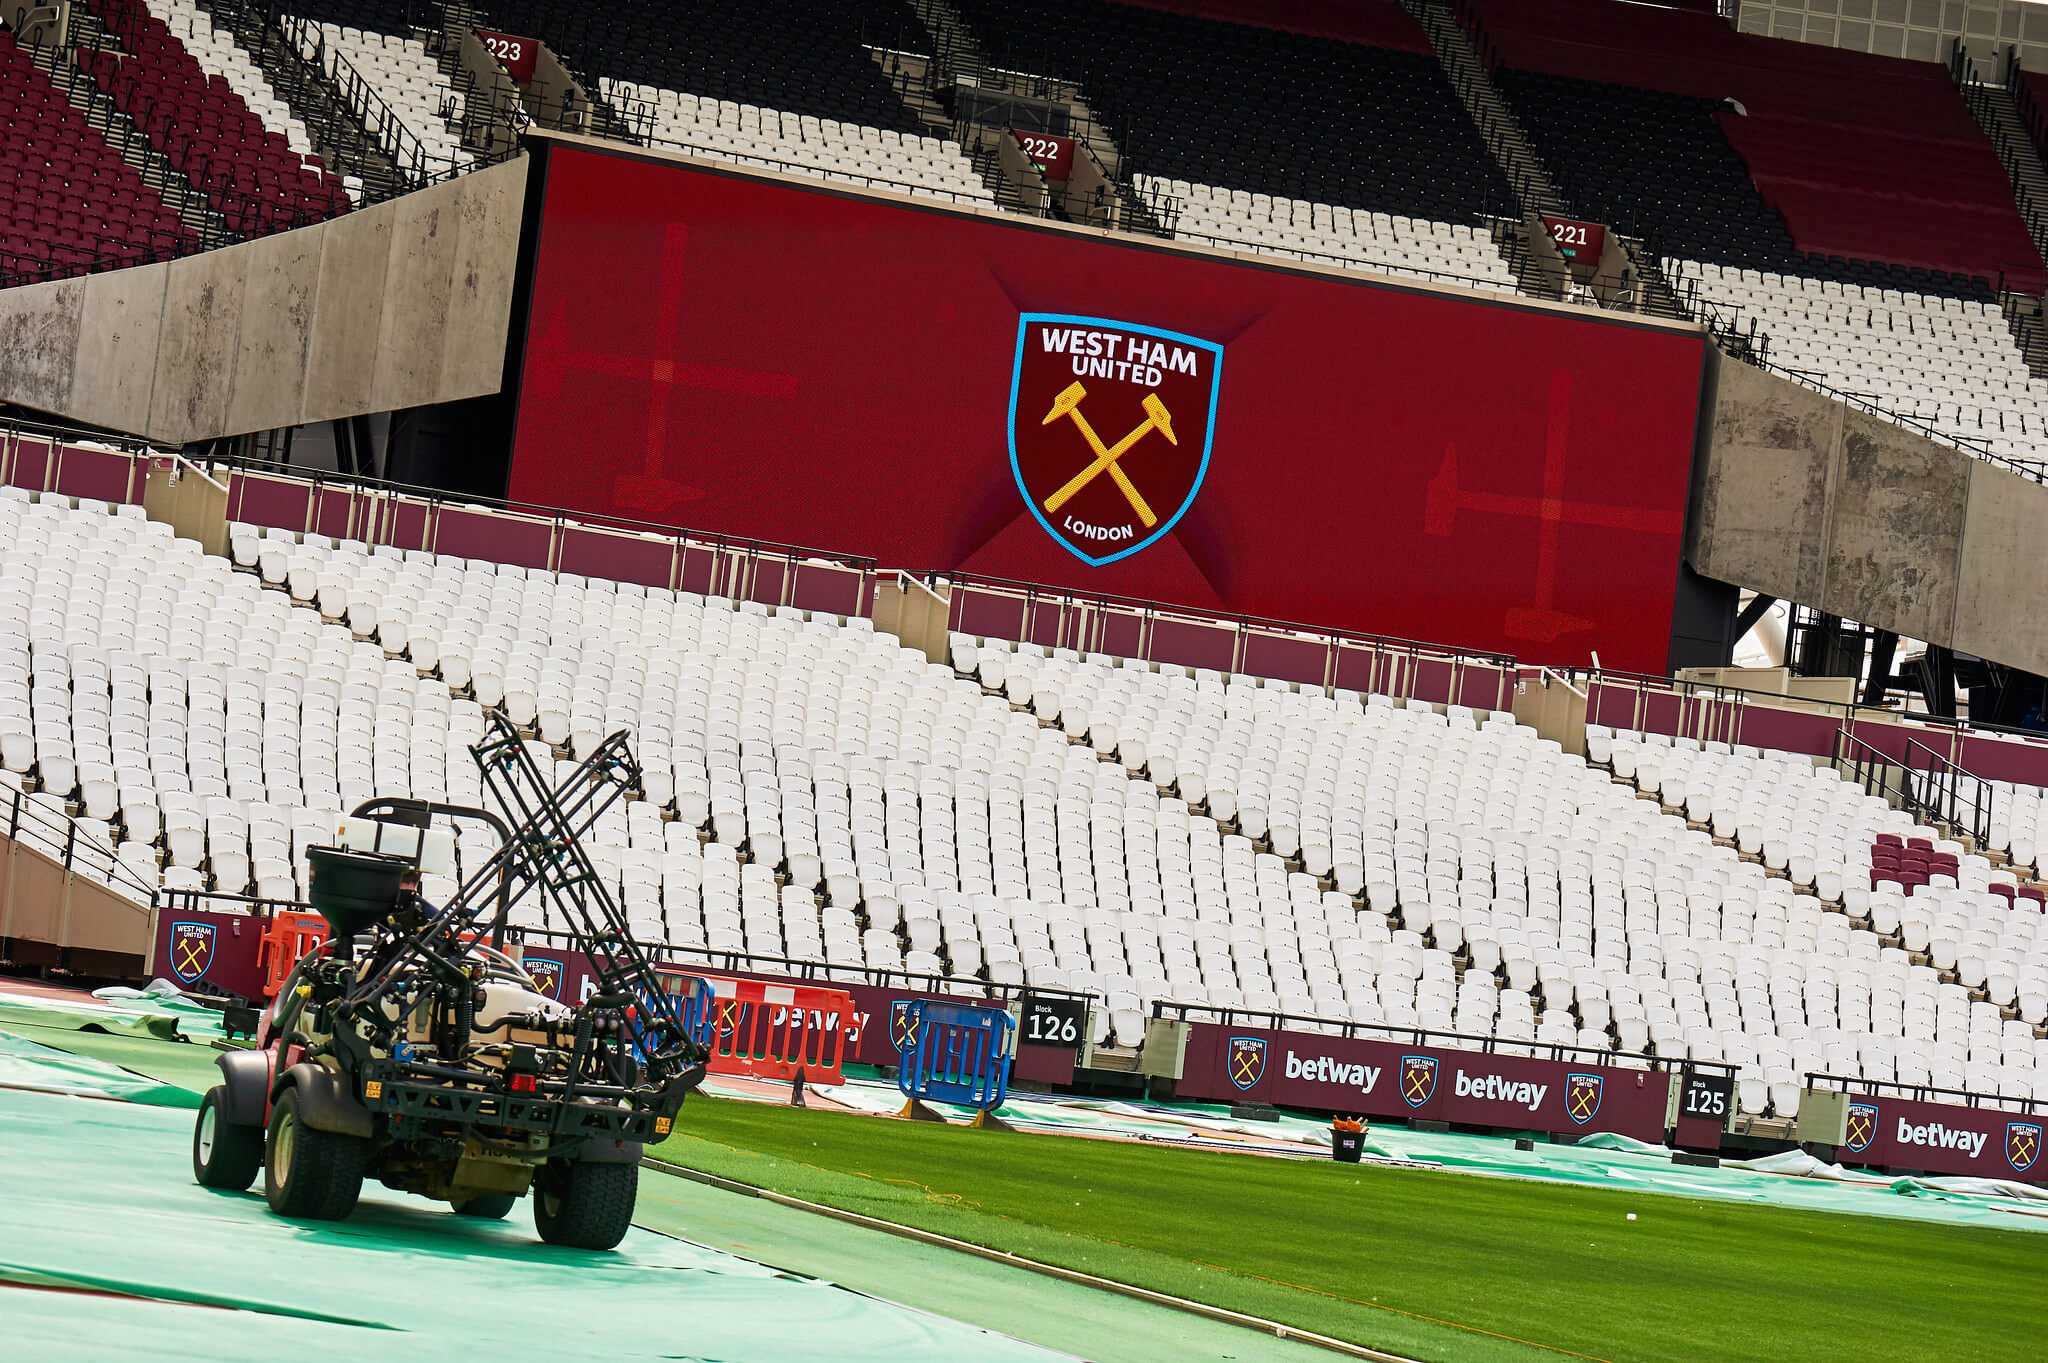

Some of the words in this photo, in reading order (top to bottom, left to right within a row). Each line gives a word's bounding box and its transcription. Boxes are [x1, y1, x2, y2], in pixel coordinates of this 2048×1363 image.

[486, 38, 521, 61] 223
[1023, 137, 1059, 160] 222
[1553, 224, 1587, 246] 221
[1042, 328, 1122, 358] WEST
[1127, 338, 1197, 376] HAM
[1072, 355, 1163, 387] UNITED
[1063, 515, 1134, 541] LONDON
[177, 925, 196, 933] WEST
[195, 926, 212, 936] HAM
[526, 961, 543, 969] WEST
[543, 962, 559, 972] HAM
[532, 967, 552, 975] UNITED
[1035, 1004, 1052, 1014] Block
[1028, 1014, 1077, 1042] 126
[1233, 1040, 1250, 1048] WEST
[1249, 1041, 1263, 1049] HAM
[1285, 1050, 1382, 1095] betway
[1455, 1069, 1548, 1112] betway
[1692, 1080, 1706, 1089] Block
[1686, 1089, 1725, 1115] 125
[1897, 1116, 1989, 1159] betway
